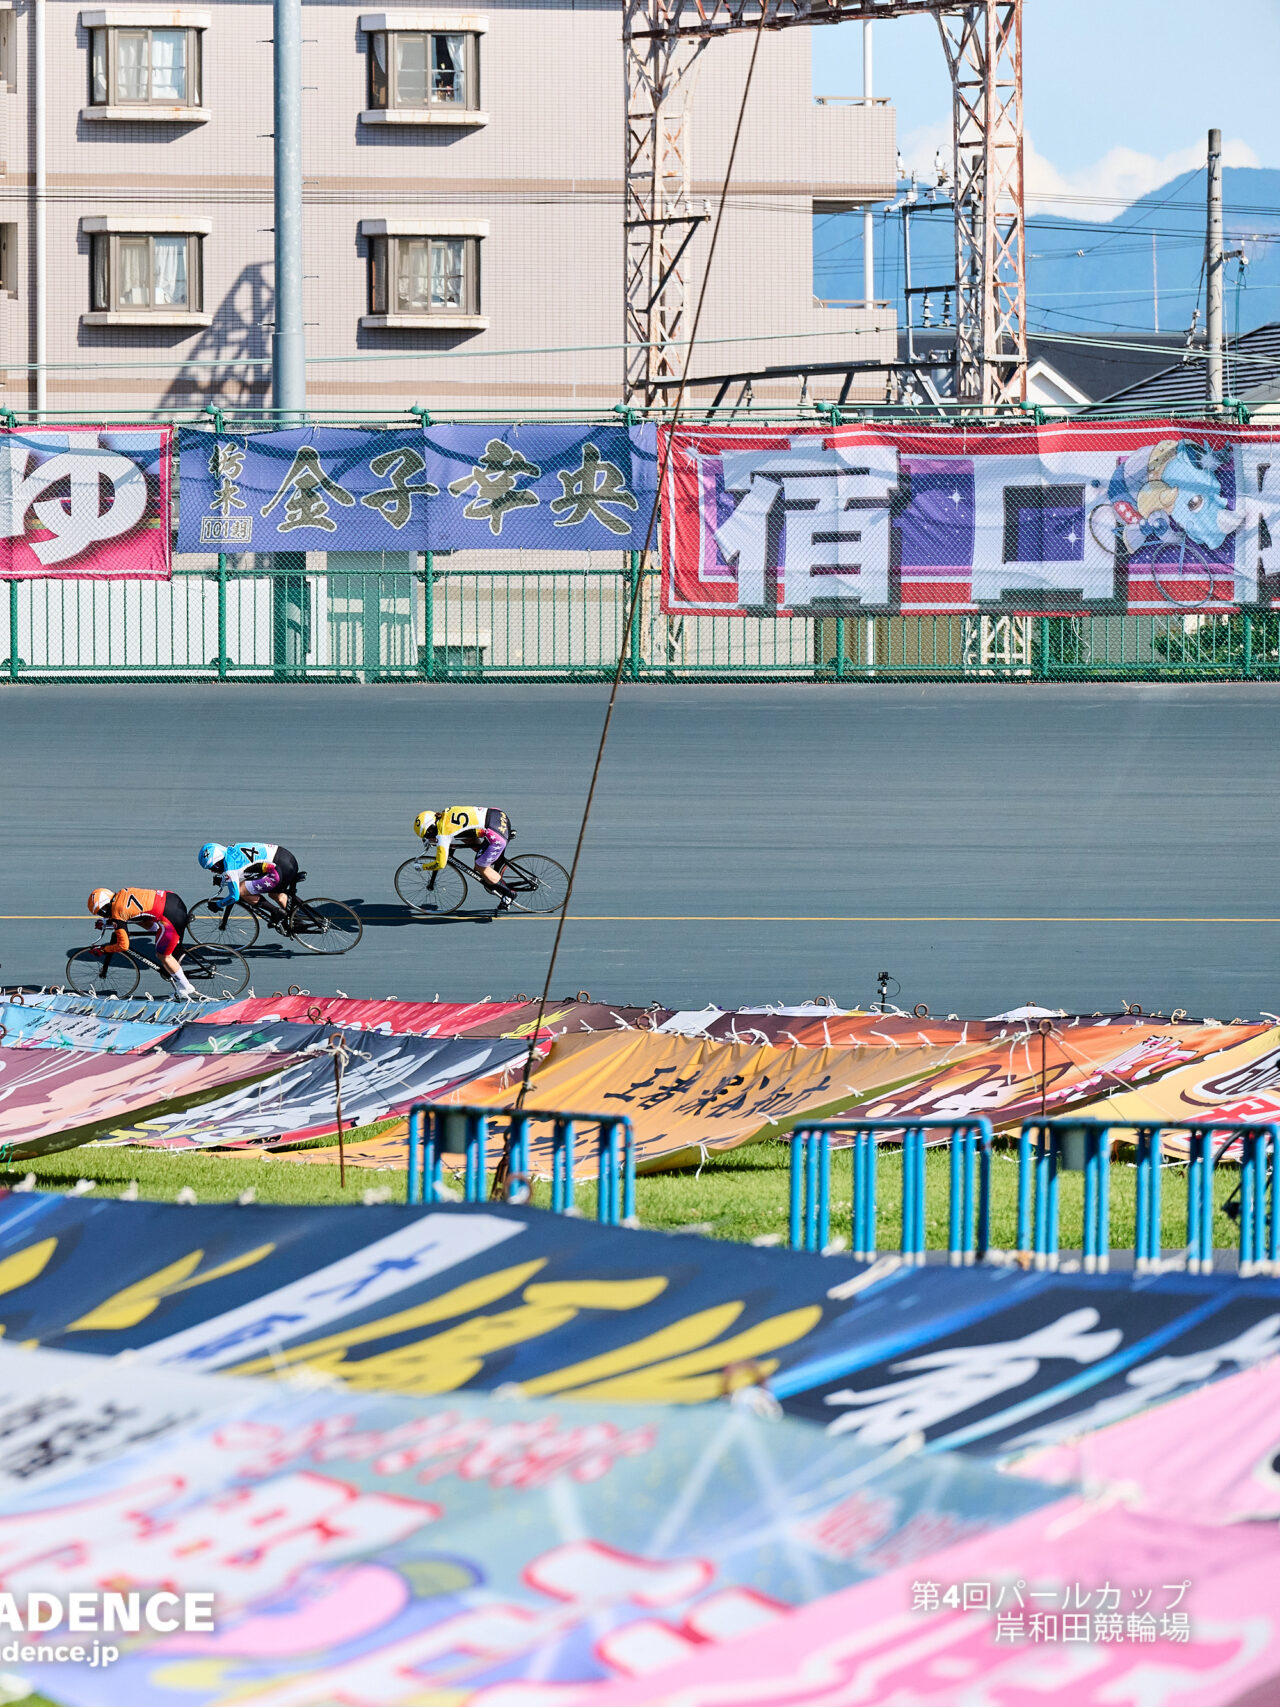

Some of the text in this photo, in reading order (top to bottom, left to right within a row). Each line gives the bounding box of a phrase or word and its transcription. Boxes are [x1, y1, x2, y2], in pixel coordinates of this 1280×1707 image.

[261, 438, 638, 535] 金子幸央
[450, 812, 470, 829] 5
[239, 846, 260, 863] 4
[126, 894, 145, 912] 7
